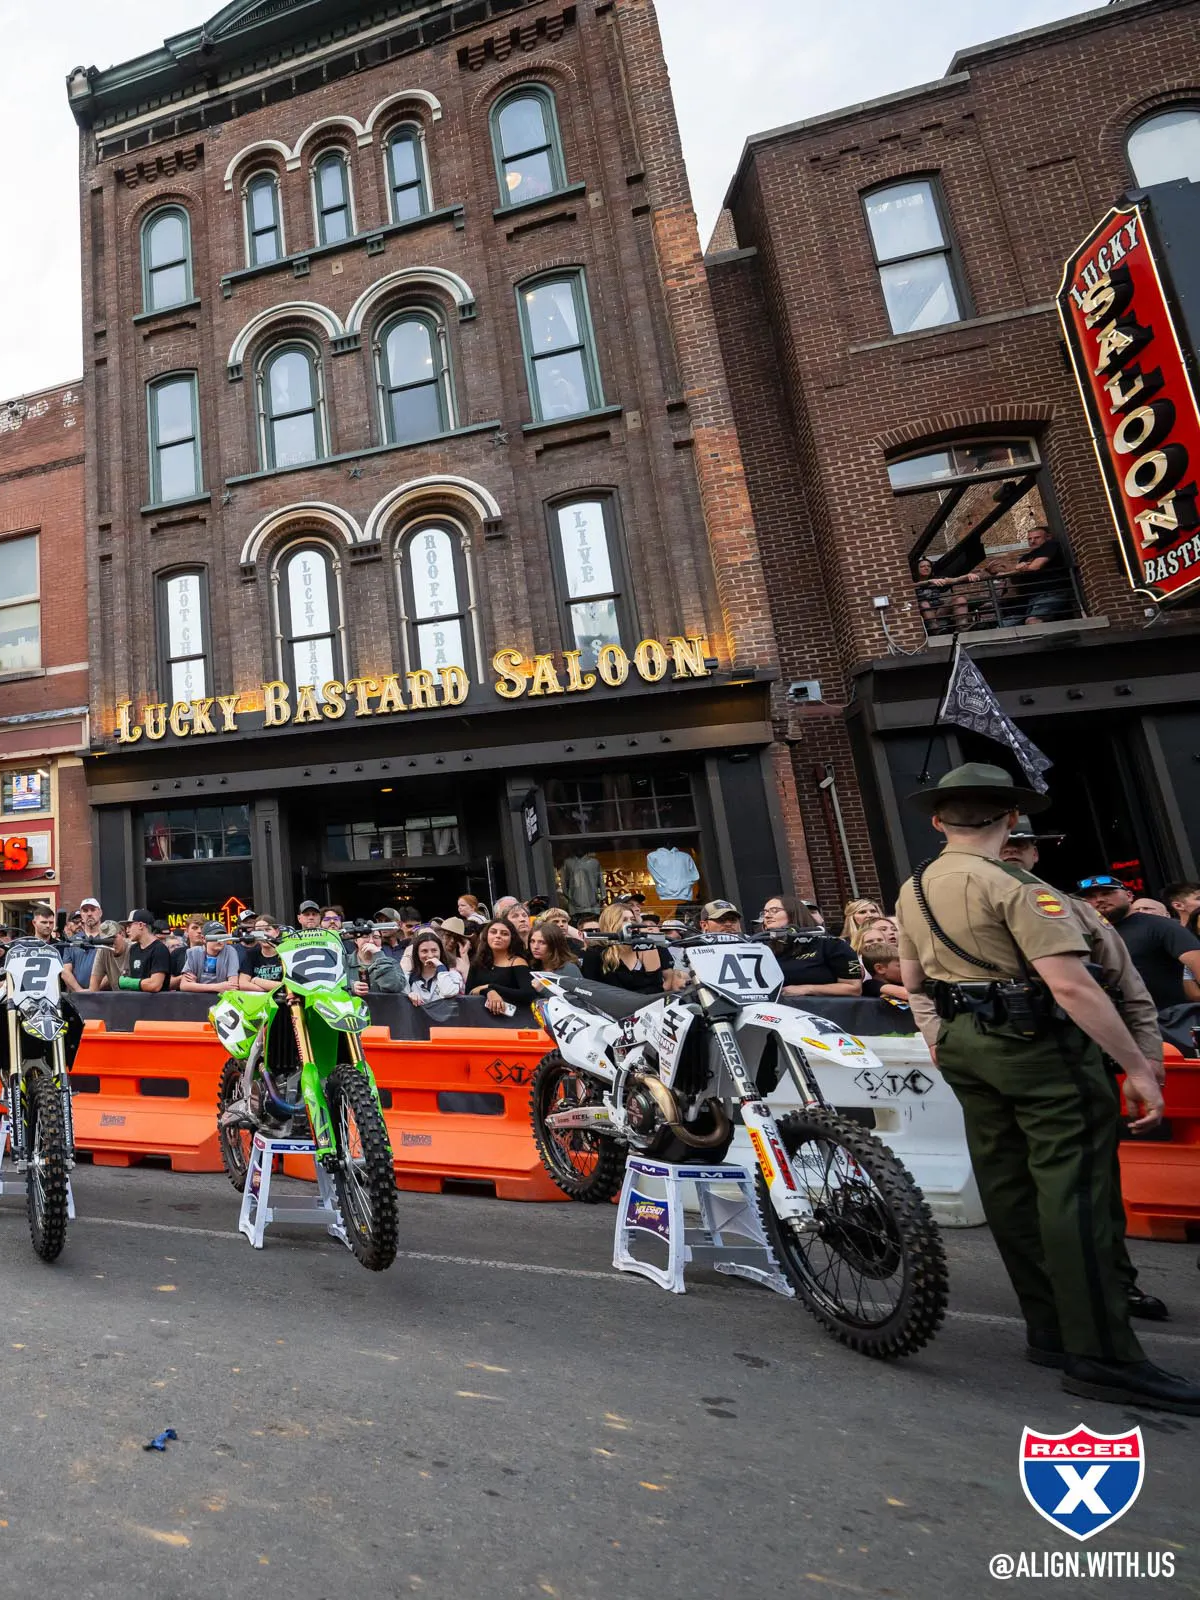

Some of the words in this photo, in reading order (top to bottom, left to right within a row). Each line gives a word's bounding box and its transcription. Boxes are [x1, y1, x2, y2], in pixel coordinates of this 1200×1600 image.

[1069, 215, 1138, 310] LUCKY
[1081, 270, 1179, 550] SALOON
[573, 511, 594, 583] LIVE
[179, 579, 191, 622] HOT
[302, 560, 314, 627] LUCKY
[115, 694, 240, 744] LUCKY
[261, 666, 471, 728] BASTARD
[493, 635, 712, 699] SALOON
[19, 957, 52, 993] 2
[291, 947, 338, 985] 2
[718, 953, 770, 990] 47
[553, 1013, 591, 1044] 47
[719, 1031, 746, 1078] ENZO
[635, 1204, 666, 1217] HOLESHOT
